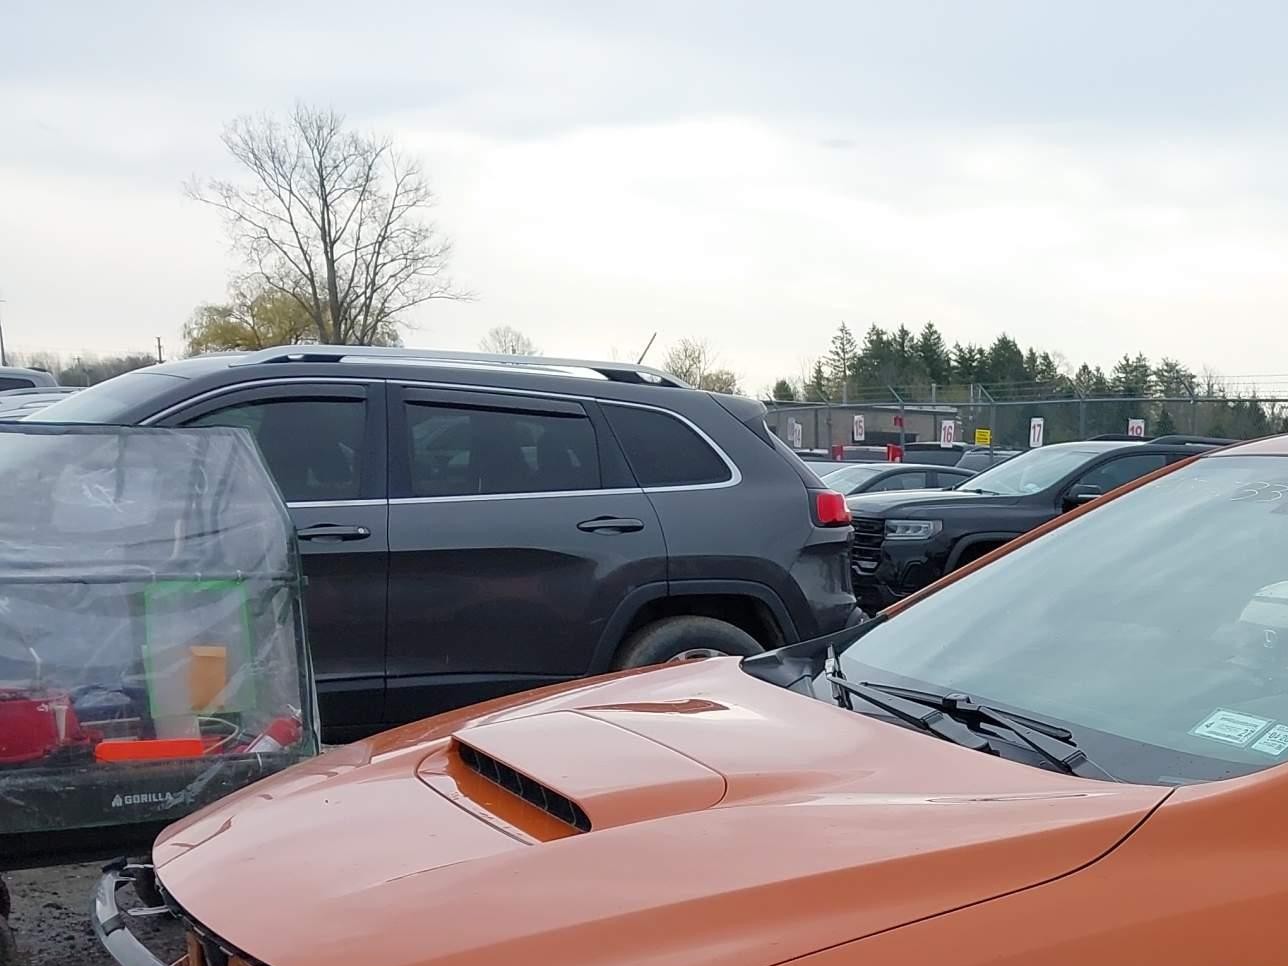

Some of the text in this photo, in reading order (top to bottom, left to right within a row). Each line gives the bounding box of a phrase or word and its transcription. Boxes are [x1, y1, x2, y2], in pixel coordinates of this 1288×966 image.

[855, 420, 863, 436] 15
[943, 426, 953, 443] 16
[1032, 424, 1042, 442] 17
[124, 791, 174, 805] GORILLA
